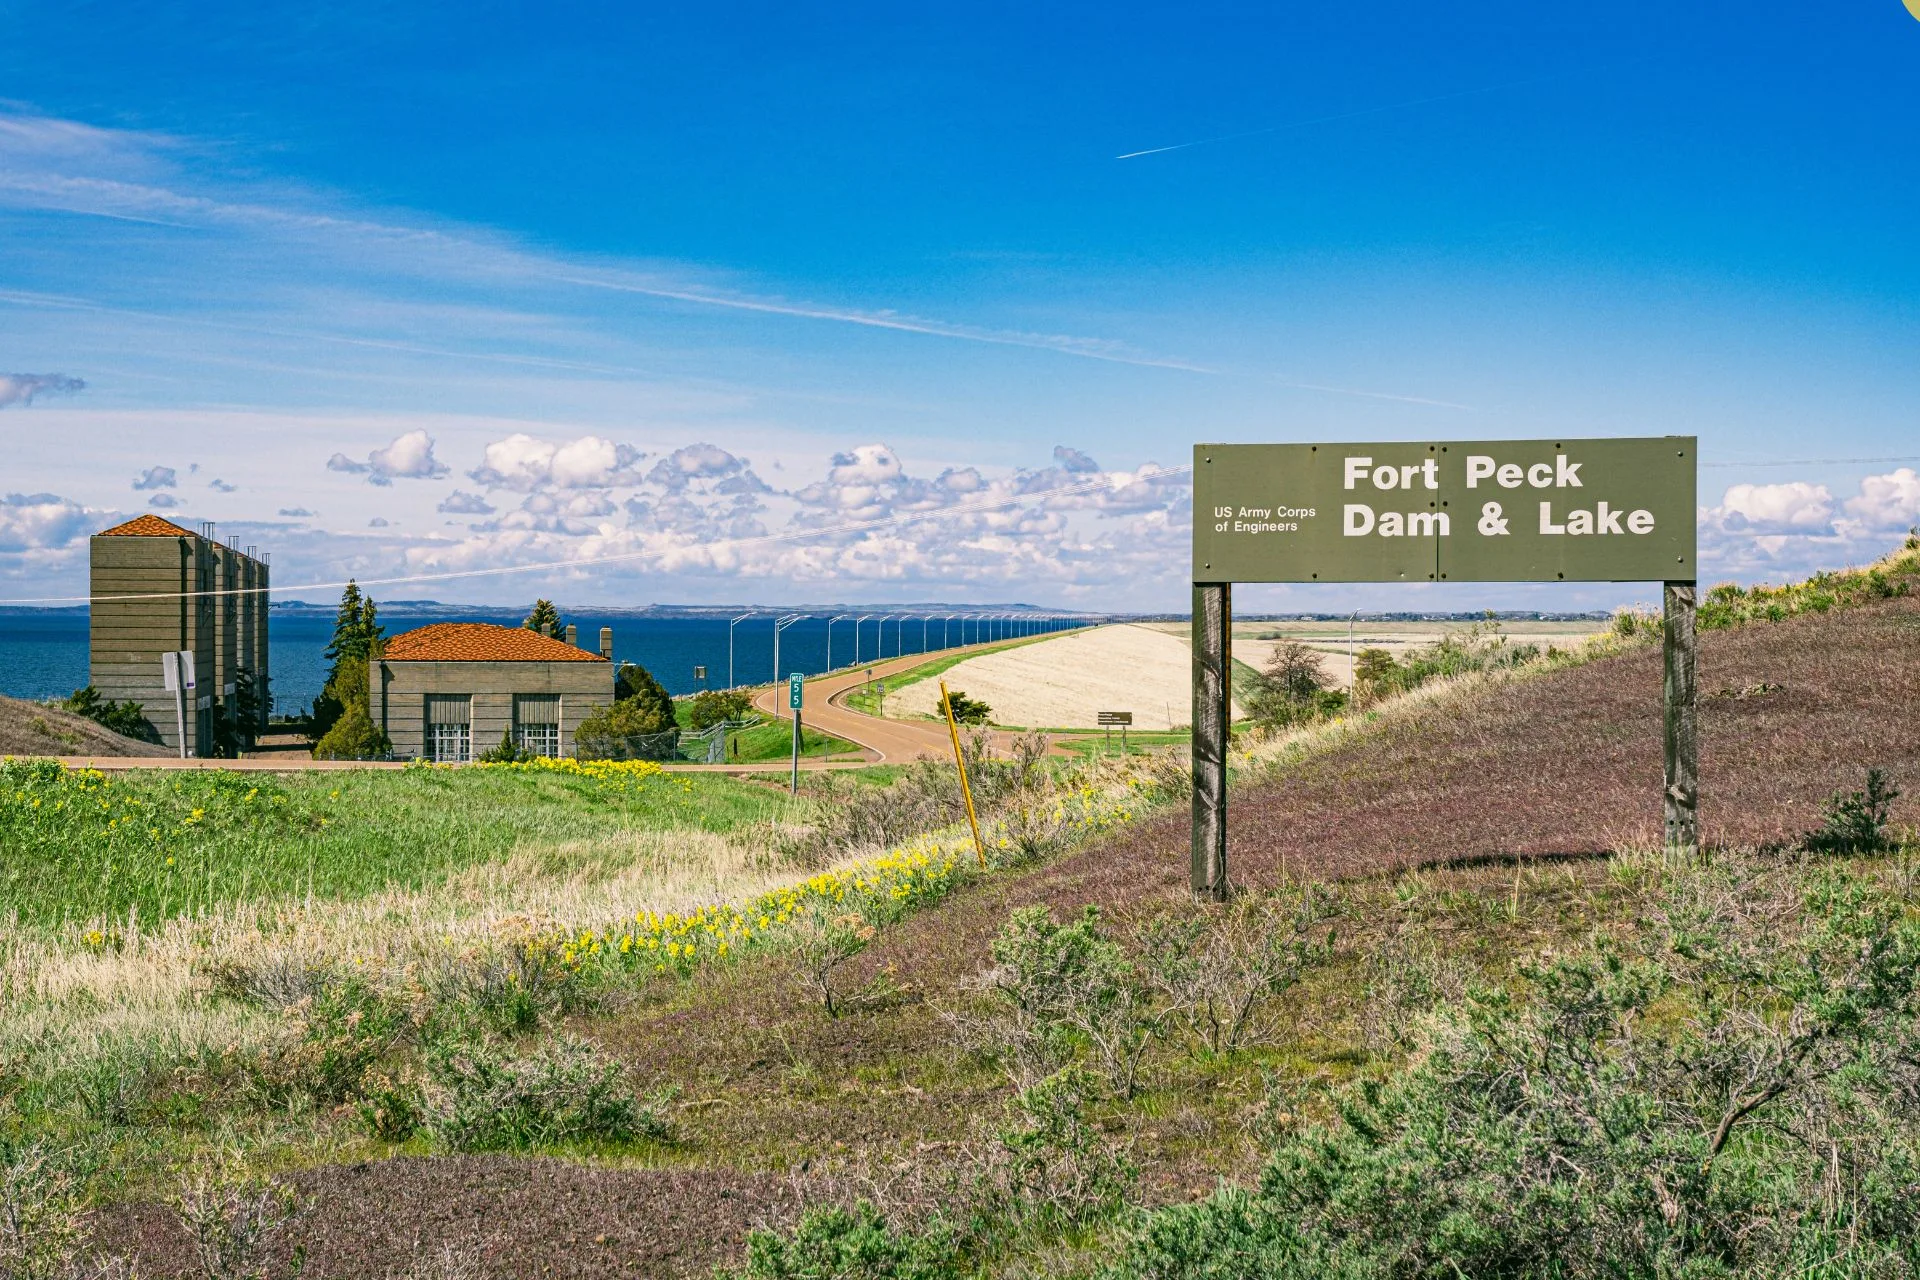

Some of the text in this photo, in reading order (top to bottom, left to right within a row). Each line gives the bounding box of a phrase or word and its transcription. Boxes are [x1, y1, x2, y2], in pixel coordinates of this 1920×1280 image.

[1344, 454, 1584, 490] Fort Peck
[1214, 505, 1316, 519] US Army Corps
[1343, 501, 1655, 537] Dam & Lake
[1215, 520, 1298, 534] of Engineers
[791, 675, 802, 683] MILE
